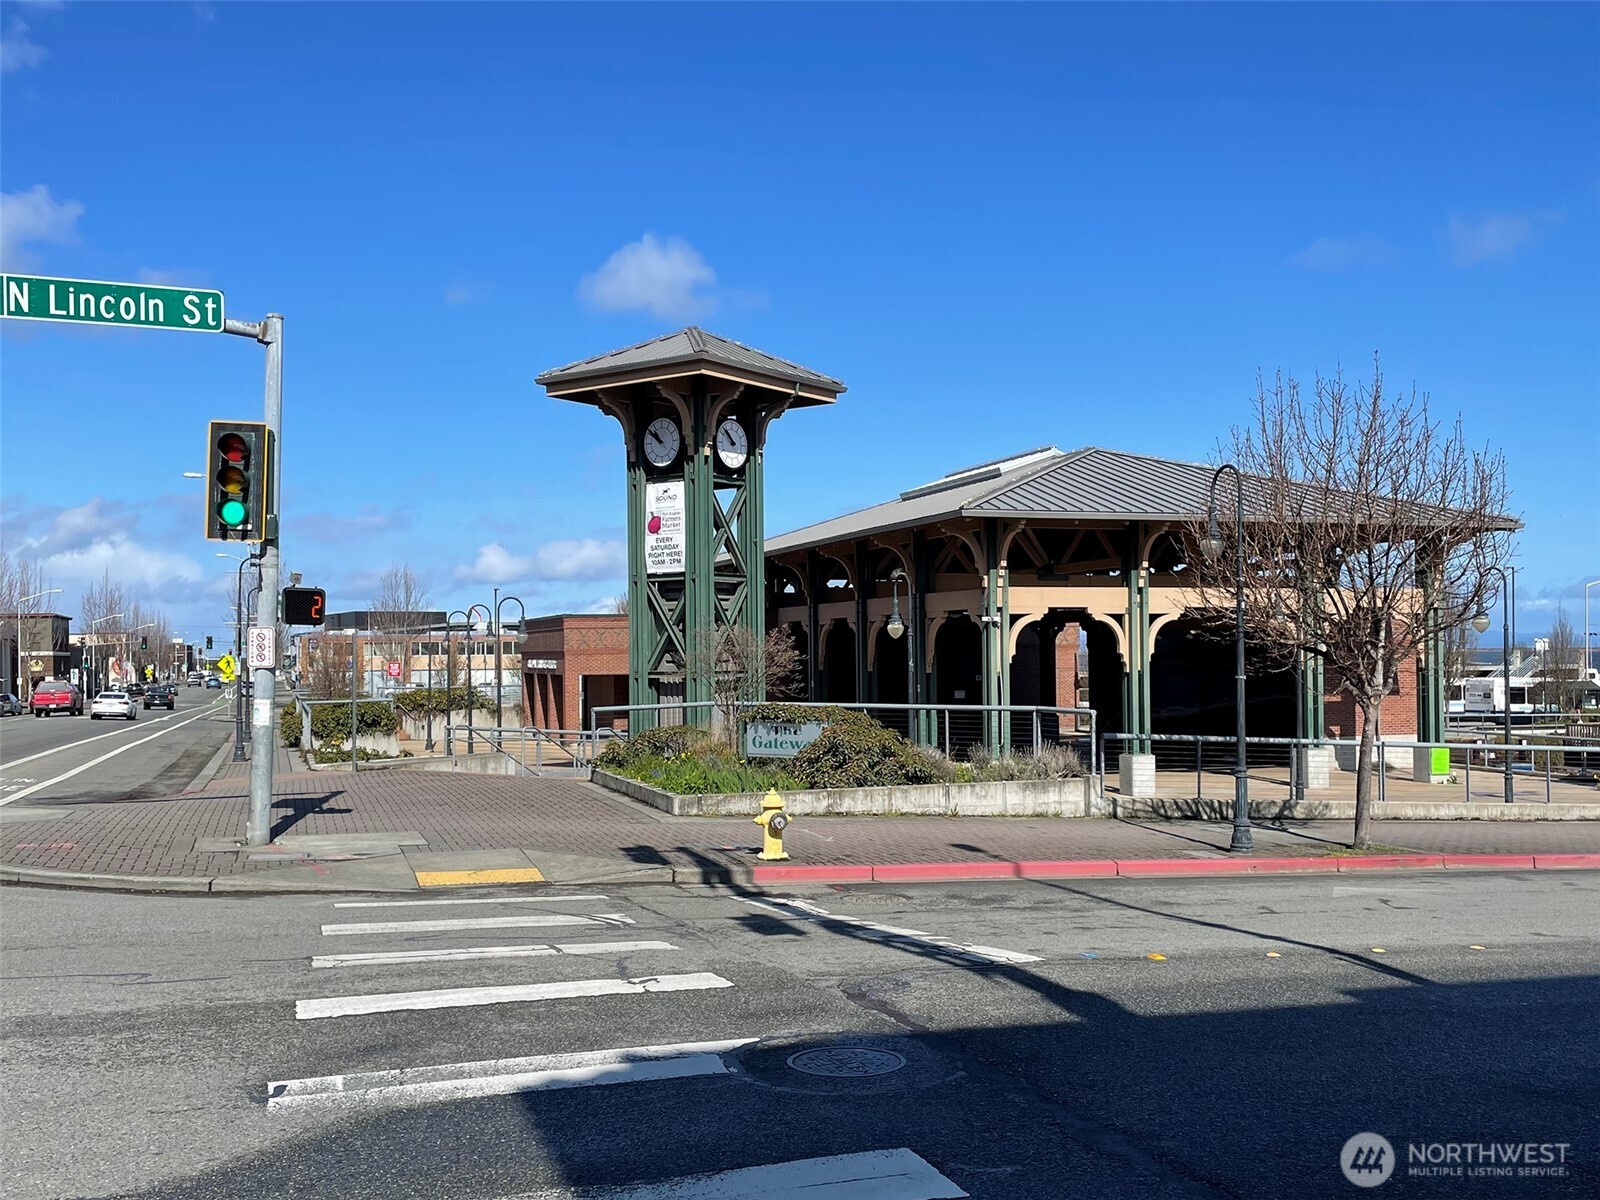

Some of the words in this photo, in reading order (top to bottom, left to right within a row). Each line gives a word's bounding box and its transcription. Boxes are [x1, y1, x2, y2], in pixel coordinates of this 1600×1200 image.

[9, 282, 29, 313] N
[49, 284, 164, 322] Lincoln
[182, 294, 217, 327] St
[655, 494, 677, 502] SOUND
[311, 595, 322, 618] 2
[771, 725, 802, 736] The
